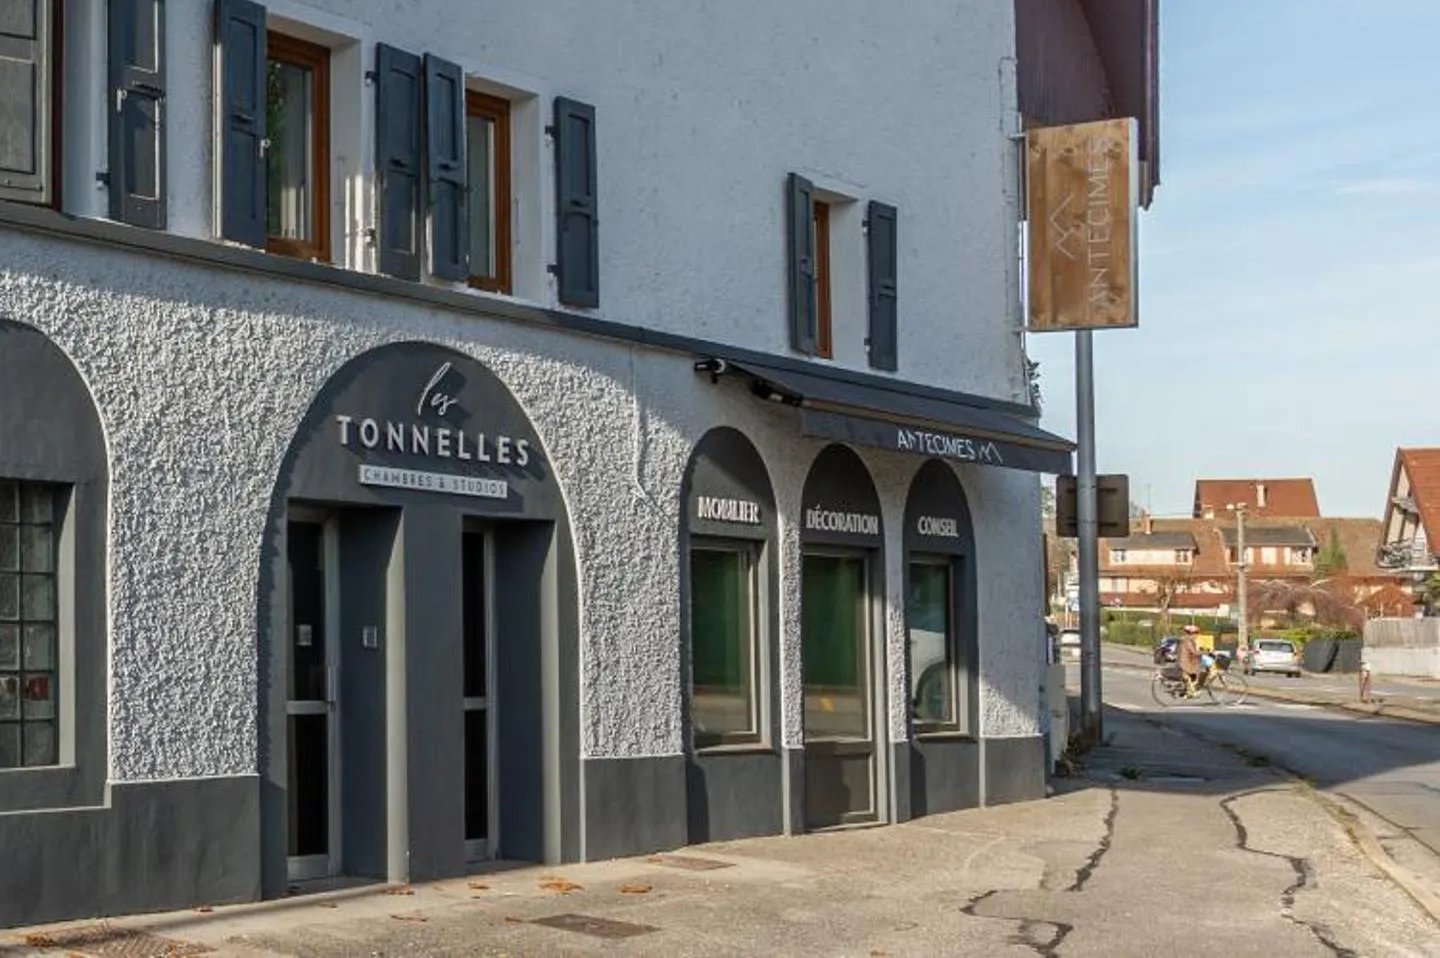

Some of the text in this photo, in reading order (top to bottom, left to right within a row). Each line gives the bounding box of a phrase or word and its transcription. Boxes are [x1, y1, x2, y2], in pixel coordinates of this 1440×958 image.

[417, 362, 458, 416] les
[335, 415, 529, 467] TONNELLES
[363, 468, 432, 487] CHAMBRES
[452, 478, 505, 495] STUDIOS
[698, 496, 760, 523] MOBILIER
[806, 504, 878, 535] DÉCORATION
[917, 516, 960, 538] CONSEIL
